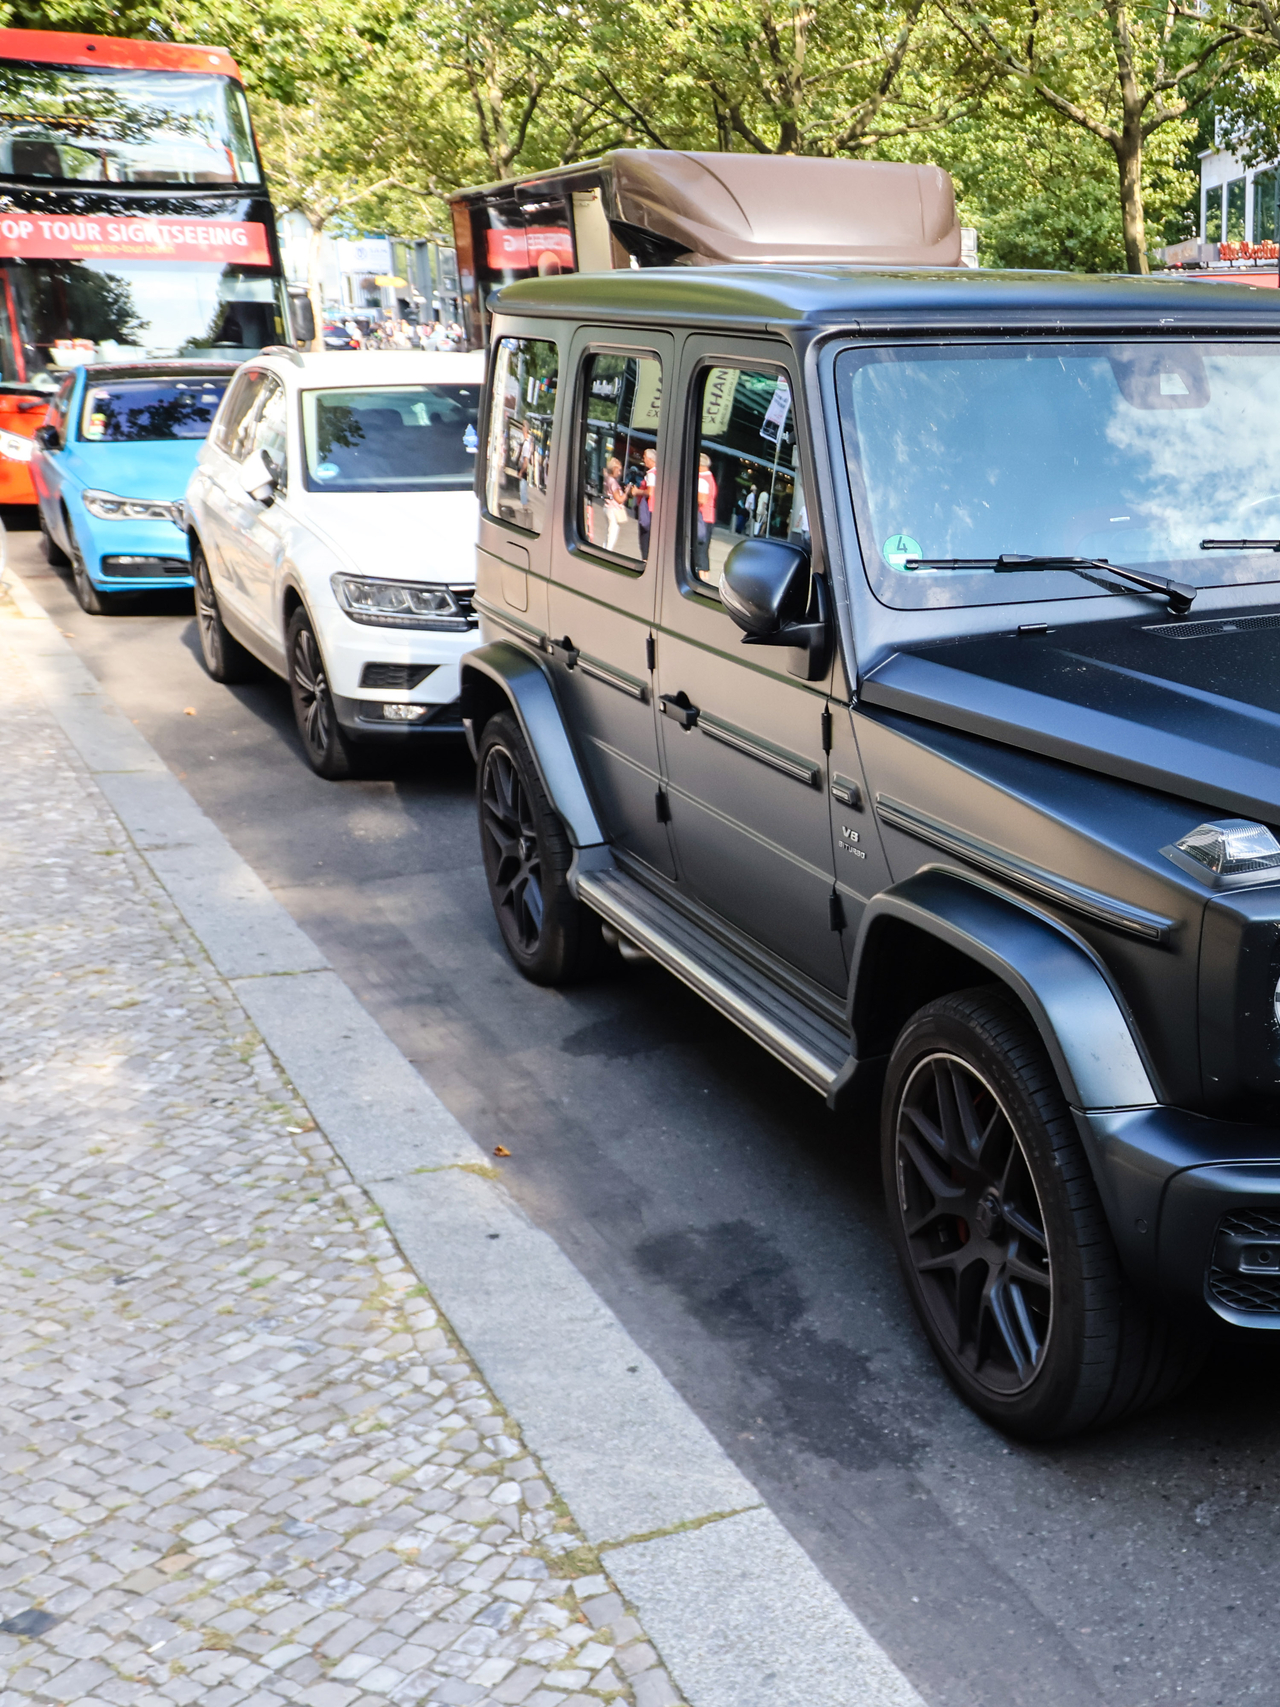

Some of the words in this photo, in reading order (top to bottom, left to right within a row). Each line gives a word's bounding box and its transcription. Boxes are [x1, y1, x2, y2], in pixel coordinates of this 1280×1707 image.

[0, 221, 33, 238] OP
[38, 221, 102, 241] TOUR
[896, 536, 908, 553] 4
[841, 826, 860, 842] V8
[838, 841, 866, 859] BITURBO
